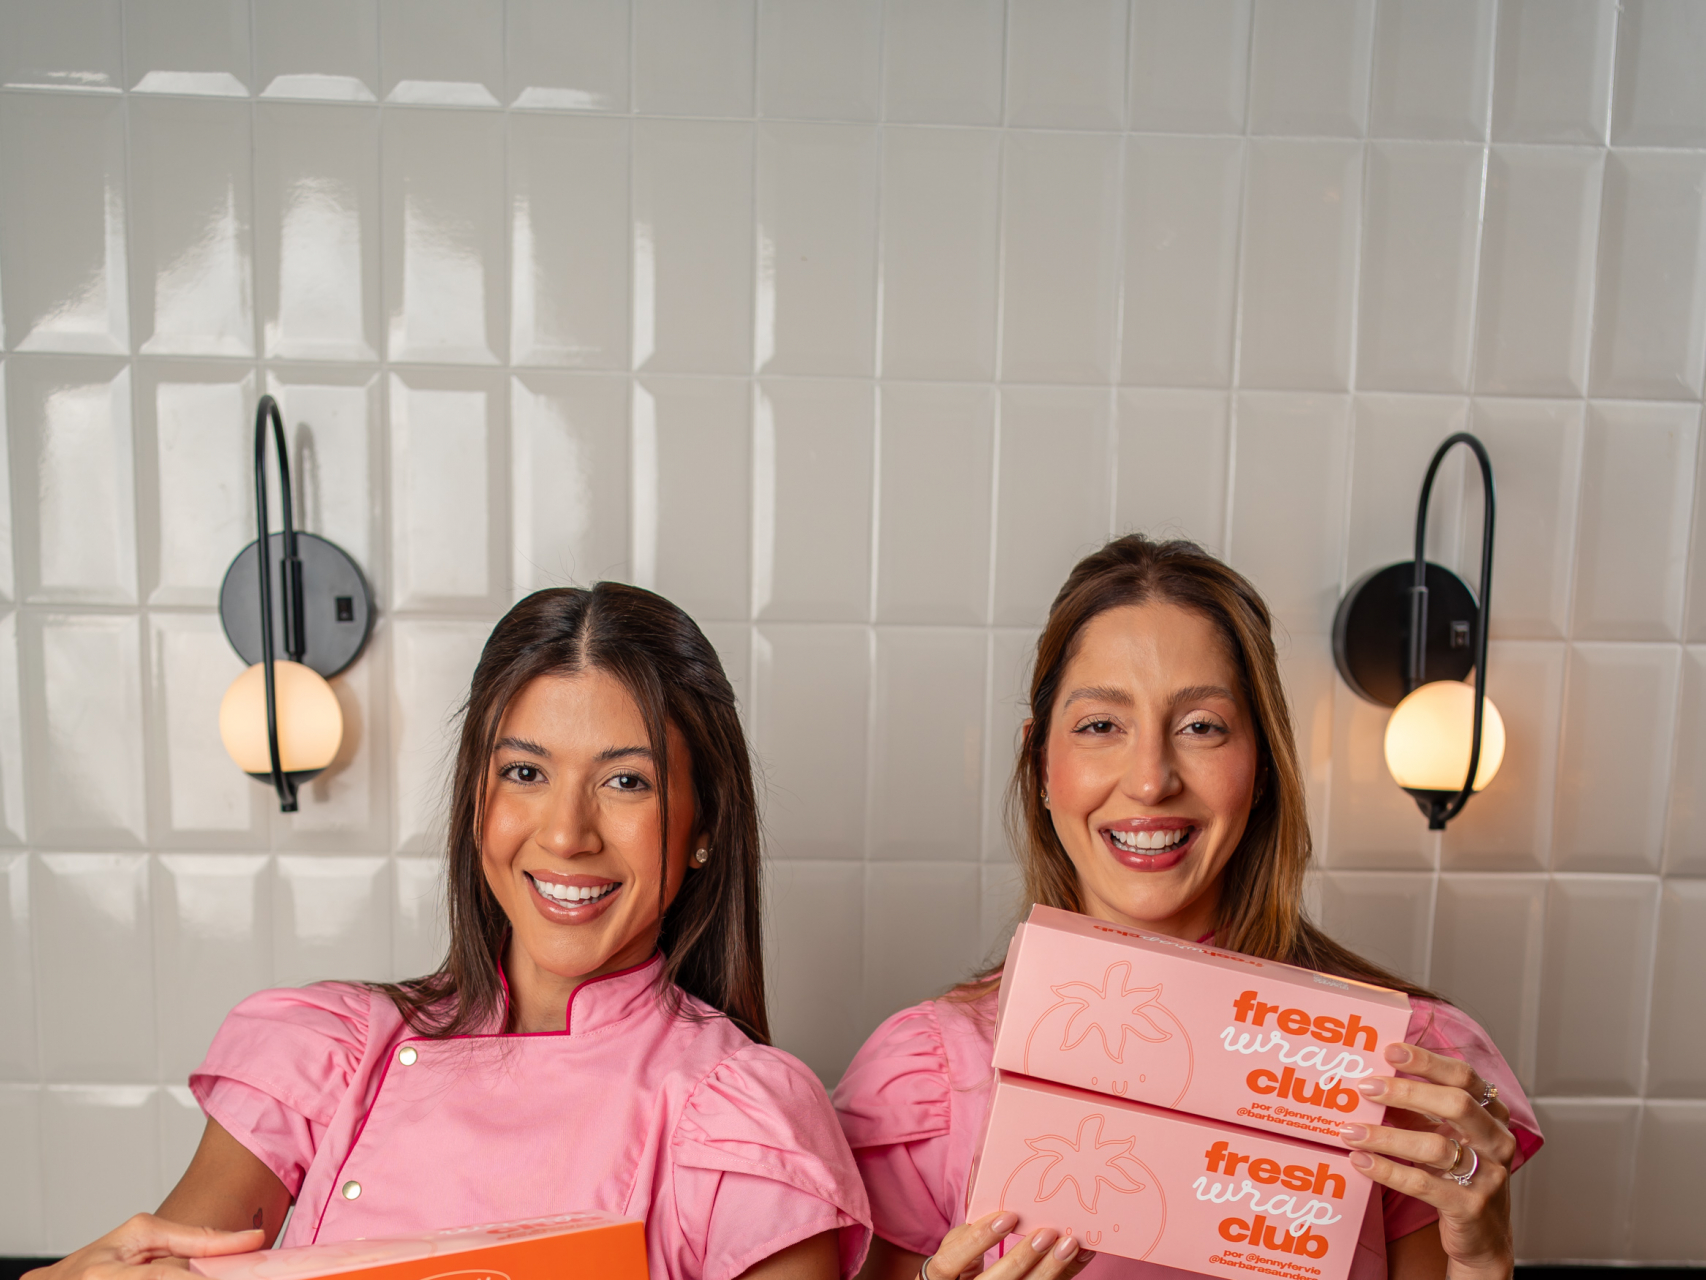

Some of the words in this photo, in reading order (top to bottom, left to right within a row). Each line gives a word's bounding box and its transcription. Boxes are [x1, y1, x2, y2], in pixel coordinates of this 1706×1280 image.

[1232, 990, 1379, 1053] fresh
[1219, 1025, 1374, 1091] wrap
[1245, 1065, 1360, 1114] club
[1236, 1106, 1341, 1138] @barbarasaunder
[1251, 1102, 1273, 1112] por
[1273, 1105, 1346, 1128] @jennyferv
[1204, 1140, 1347, 1200] fresh
[1191, 1175, 1343, 1238] wrap
[1217, 1214, 1329, 1260] club
[1223, 1249, 1245, 1259] por
[1245, 1252, 1322, 1276] @jennyfervie
